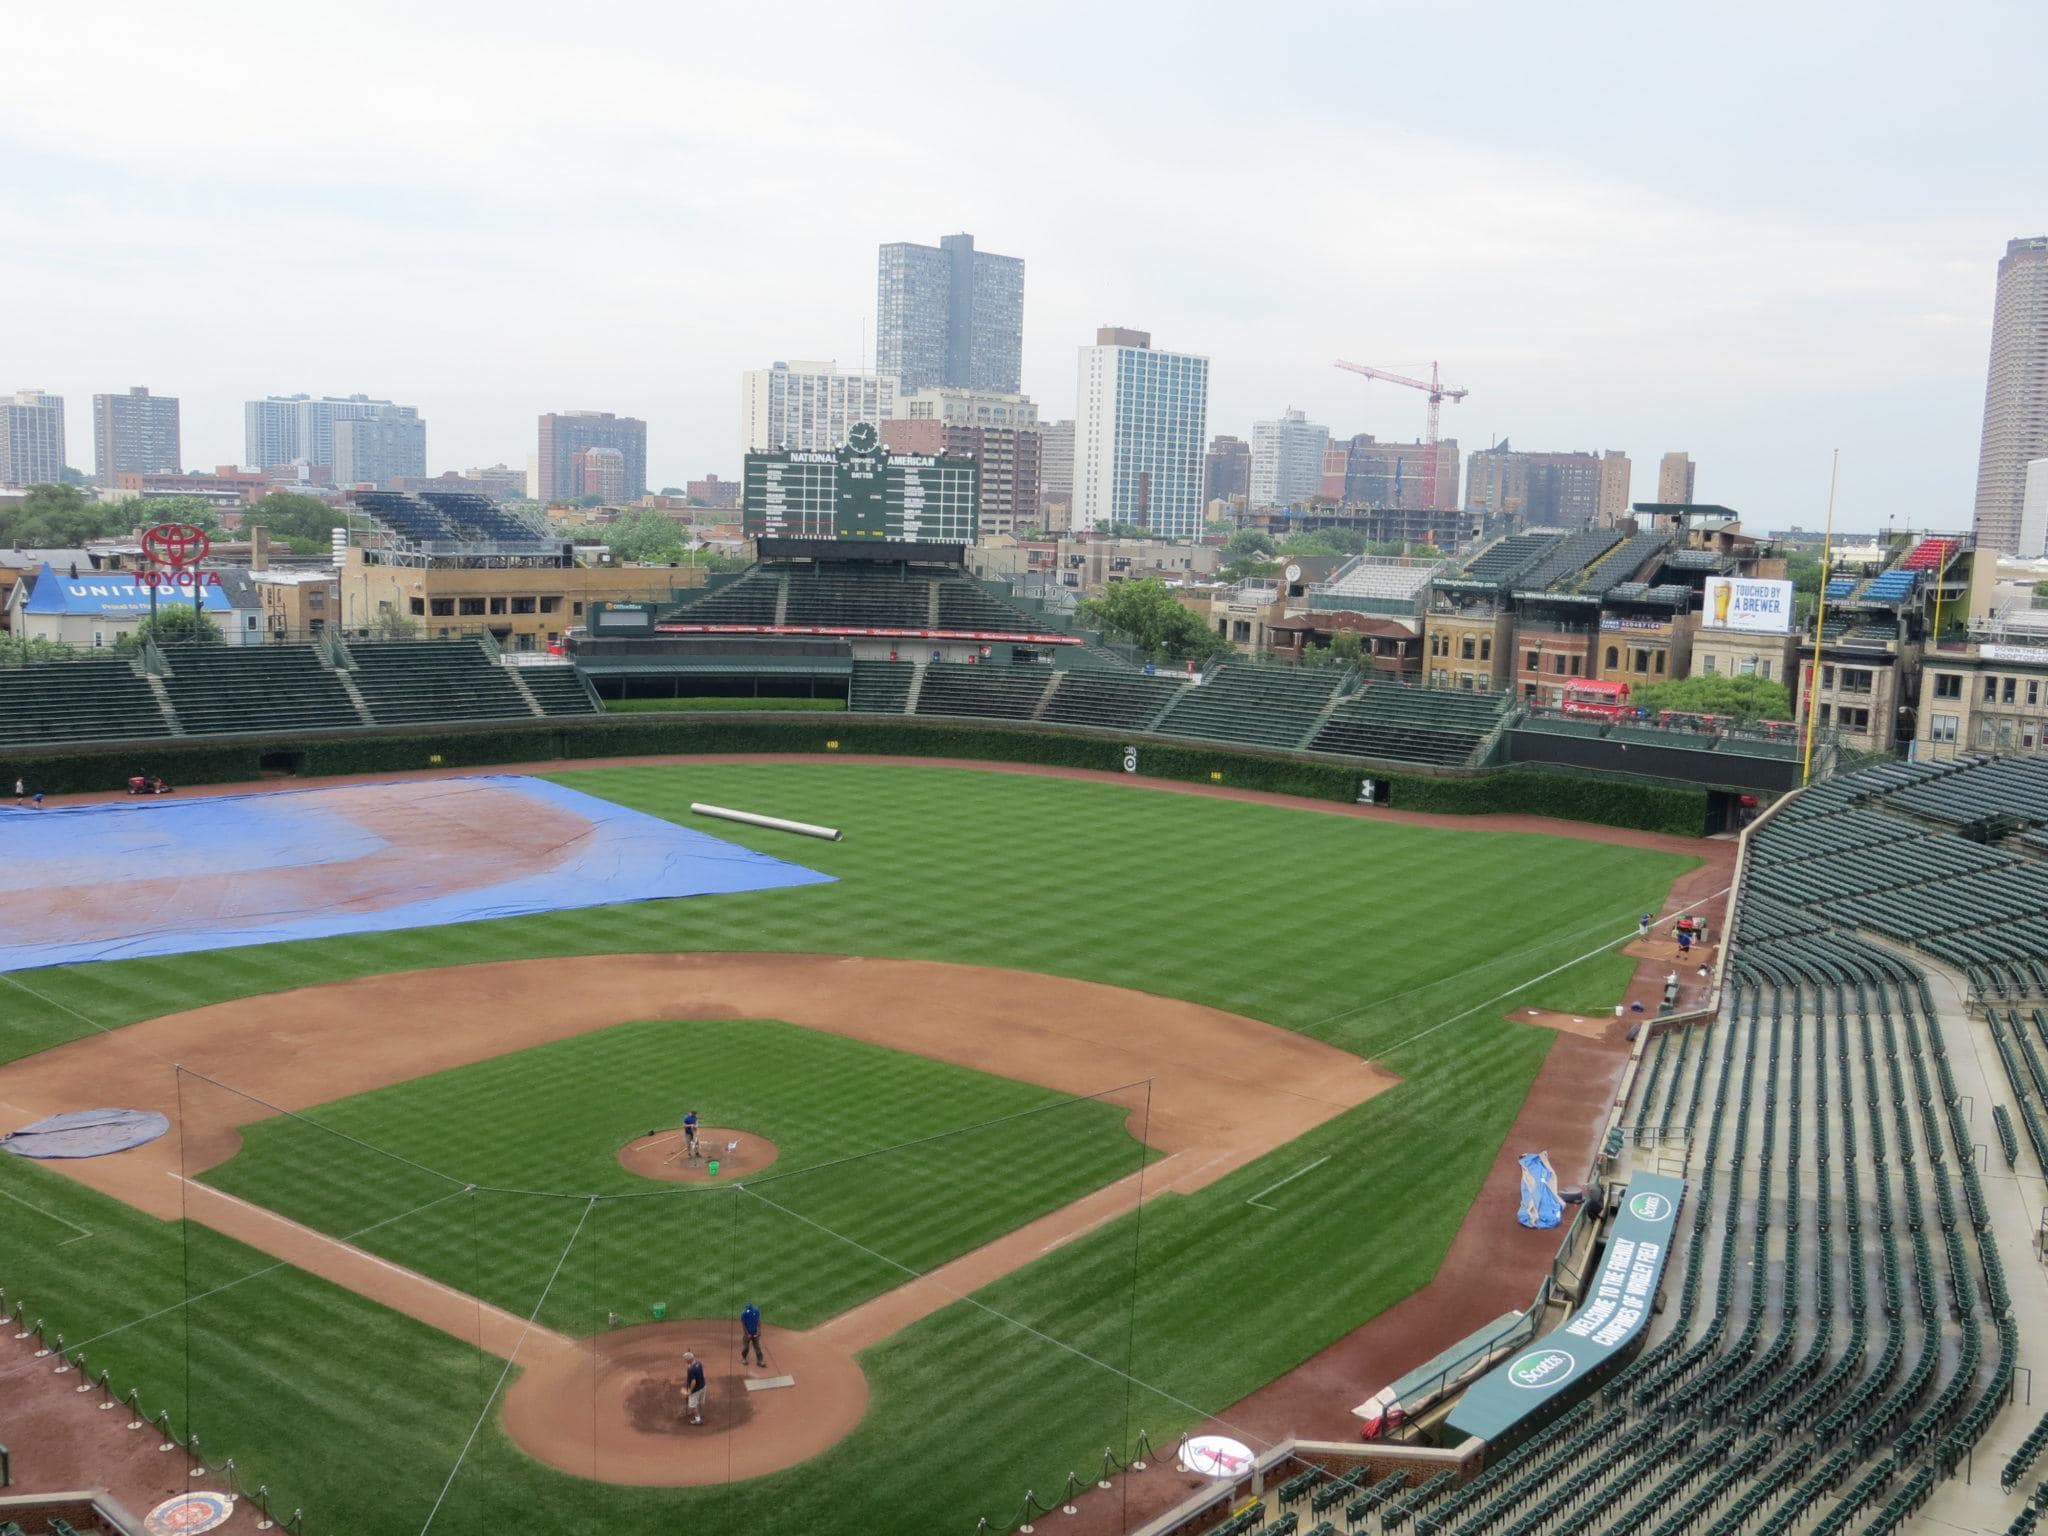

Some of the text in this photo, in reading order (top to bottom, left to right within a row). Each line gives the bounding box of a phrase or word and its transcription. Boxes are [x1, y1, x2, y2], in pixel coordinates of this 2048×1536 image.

[790, 452, 838, 464] NATIONAL
[887, 456, 935, 467] AMERICAN
[130, 571, 224, 587] TOYOTA
[68, 585, 175, 597] UNITED
[1736, 585, 1781, 599] TOUCHED BY
[1735, 598, 1740, 610] A
[1638, 1196, 1660, 1218] Scotts
[1565, 1237, 1636, 1337] WELCOME TO THE FRIENDLY
[1591, 1241, 1660, 1347] CONFINES OF WRIGLEY FIELD
[1518, 1354, 1564, 1384] Scotts
